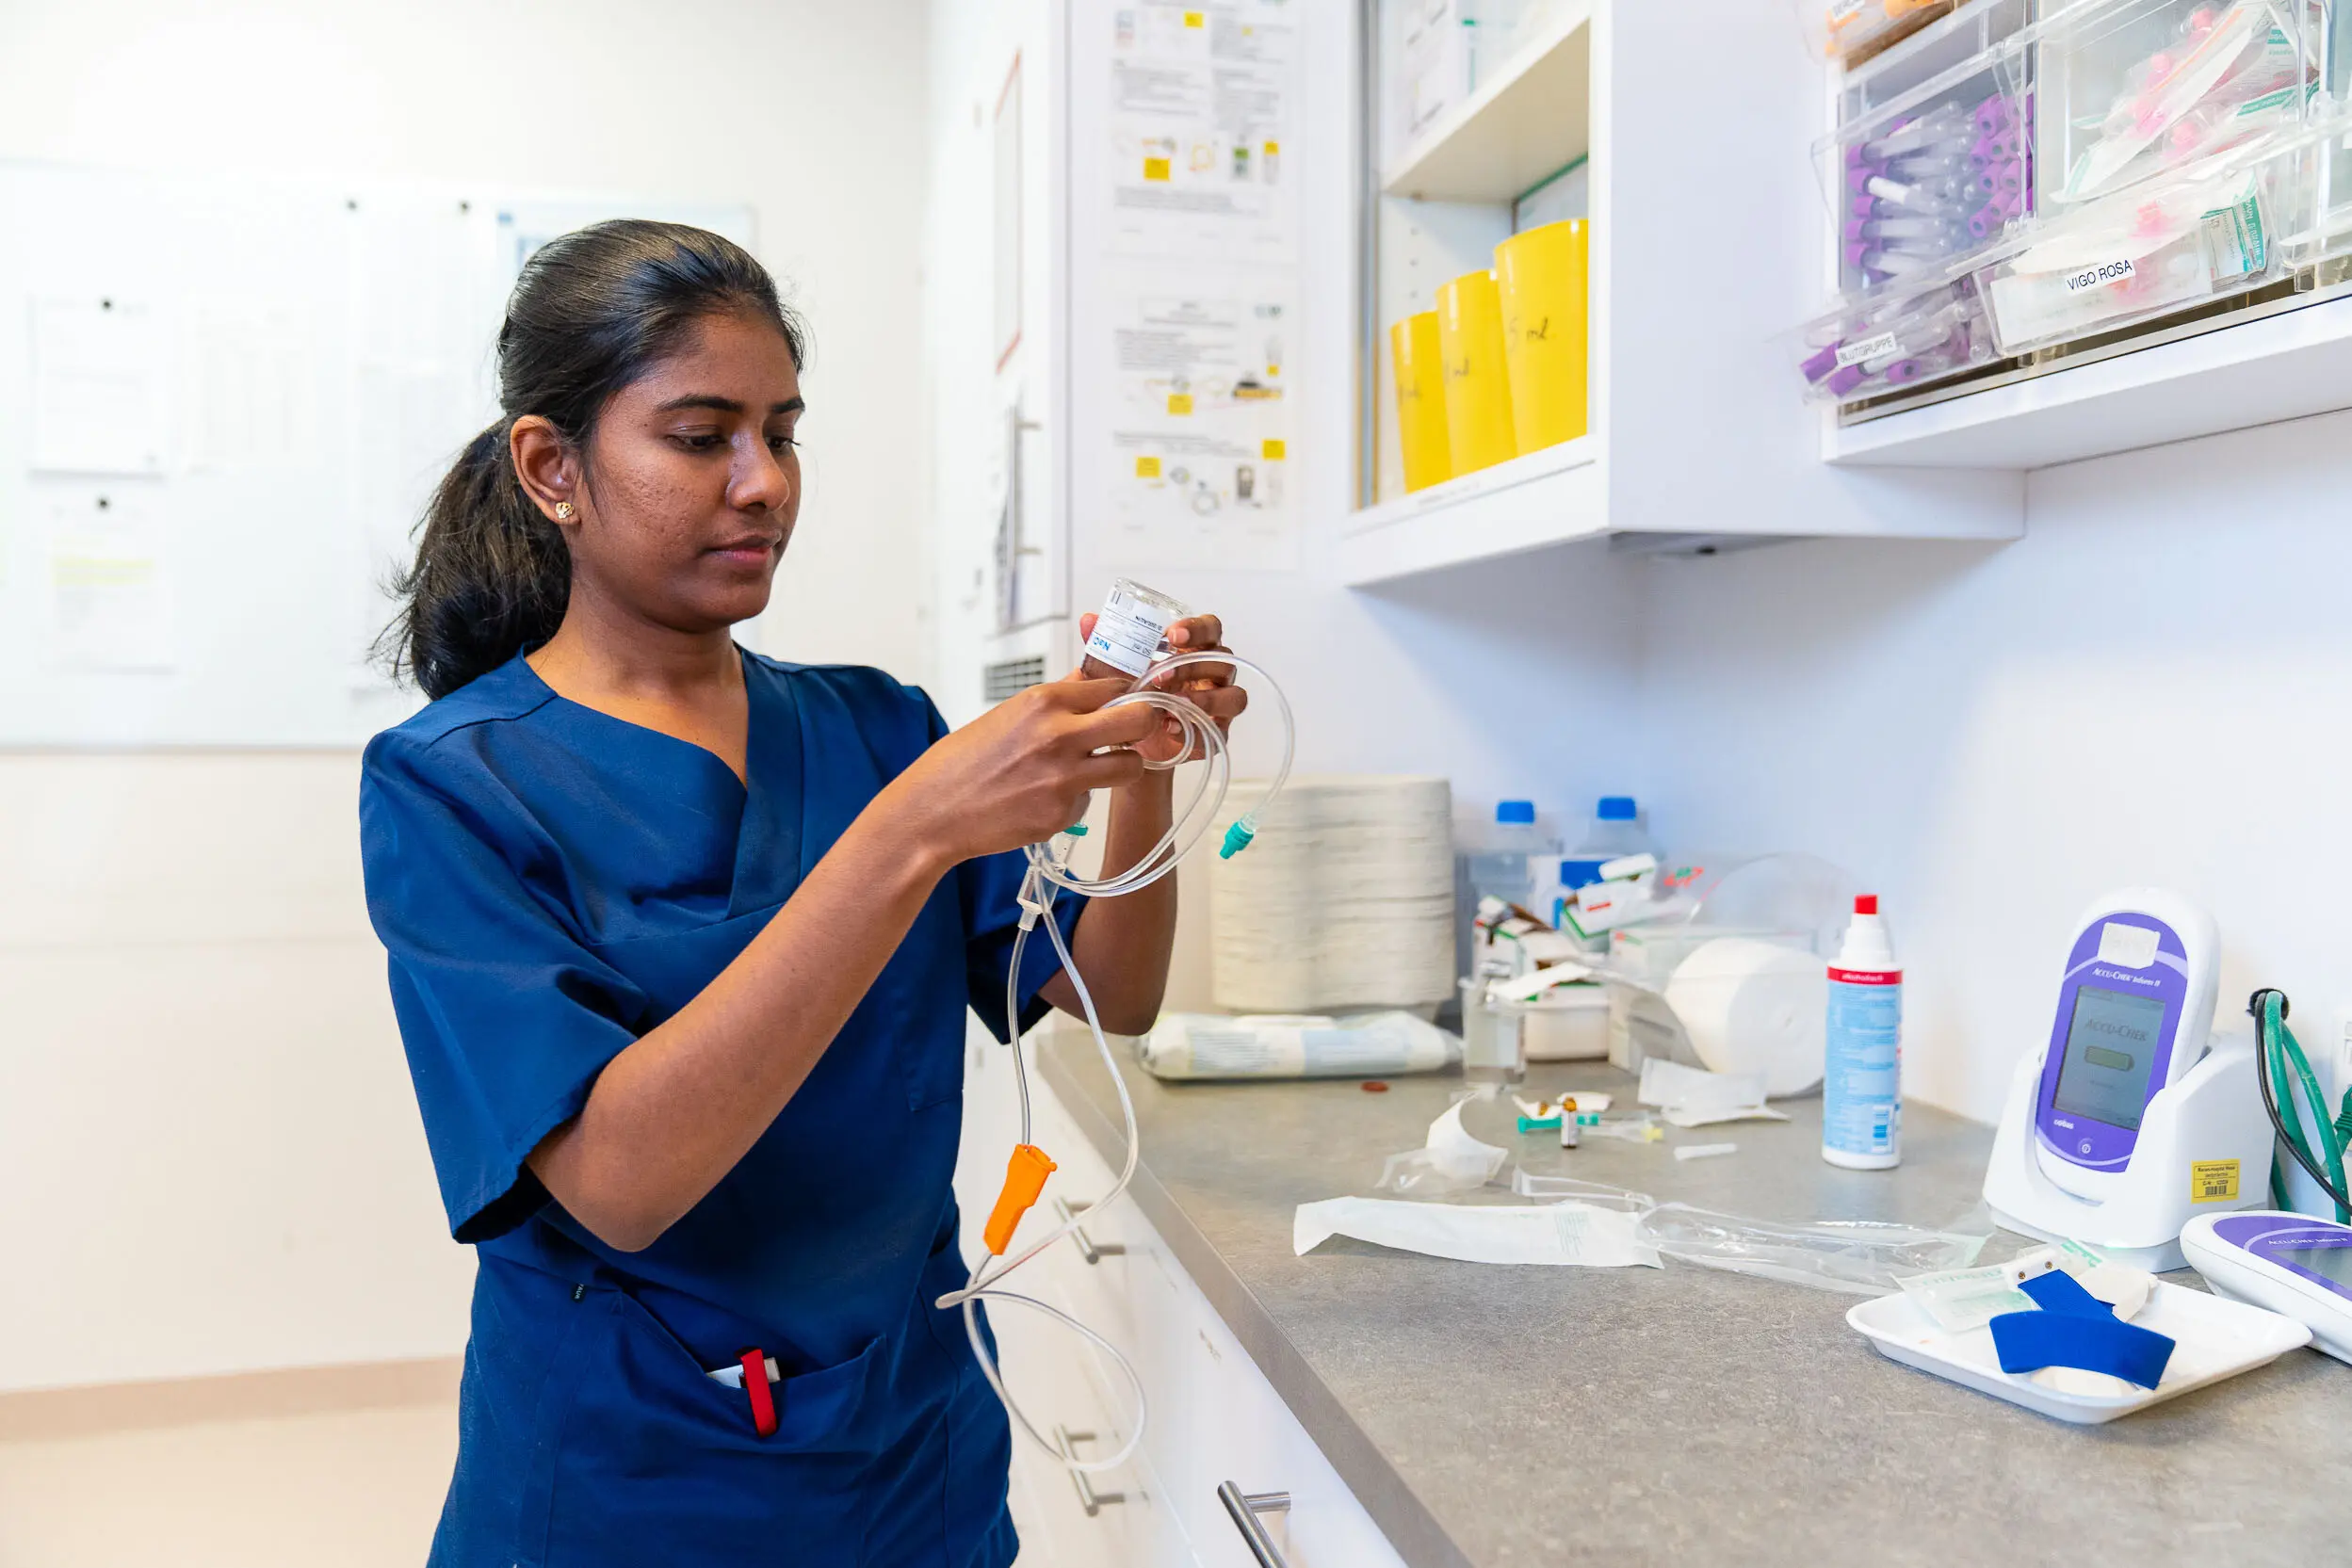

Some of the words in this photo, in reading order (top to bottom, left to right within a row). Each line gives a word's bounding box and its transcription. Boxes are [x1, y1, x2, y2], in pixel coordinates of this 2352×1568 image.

[2067, 271, 2097, 290] VIGO
[2098, 259, 2133, 281] ROSA
[2084, 1019, 2148, 1042] ACCU-CHEK
